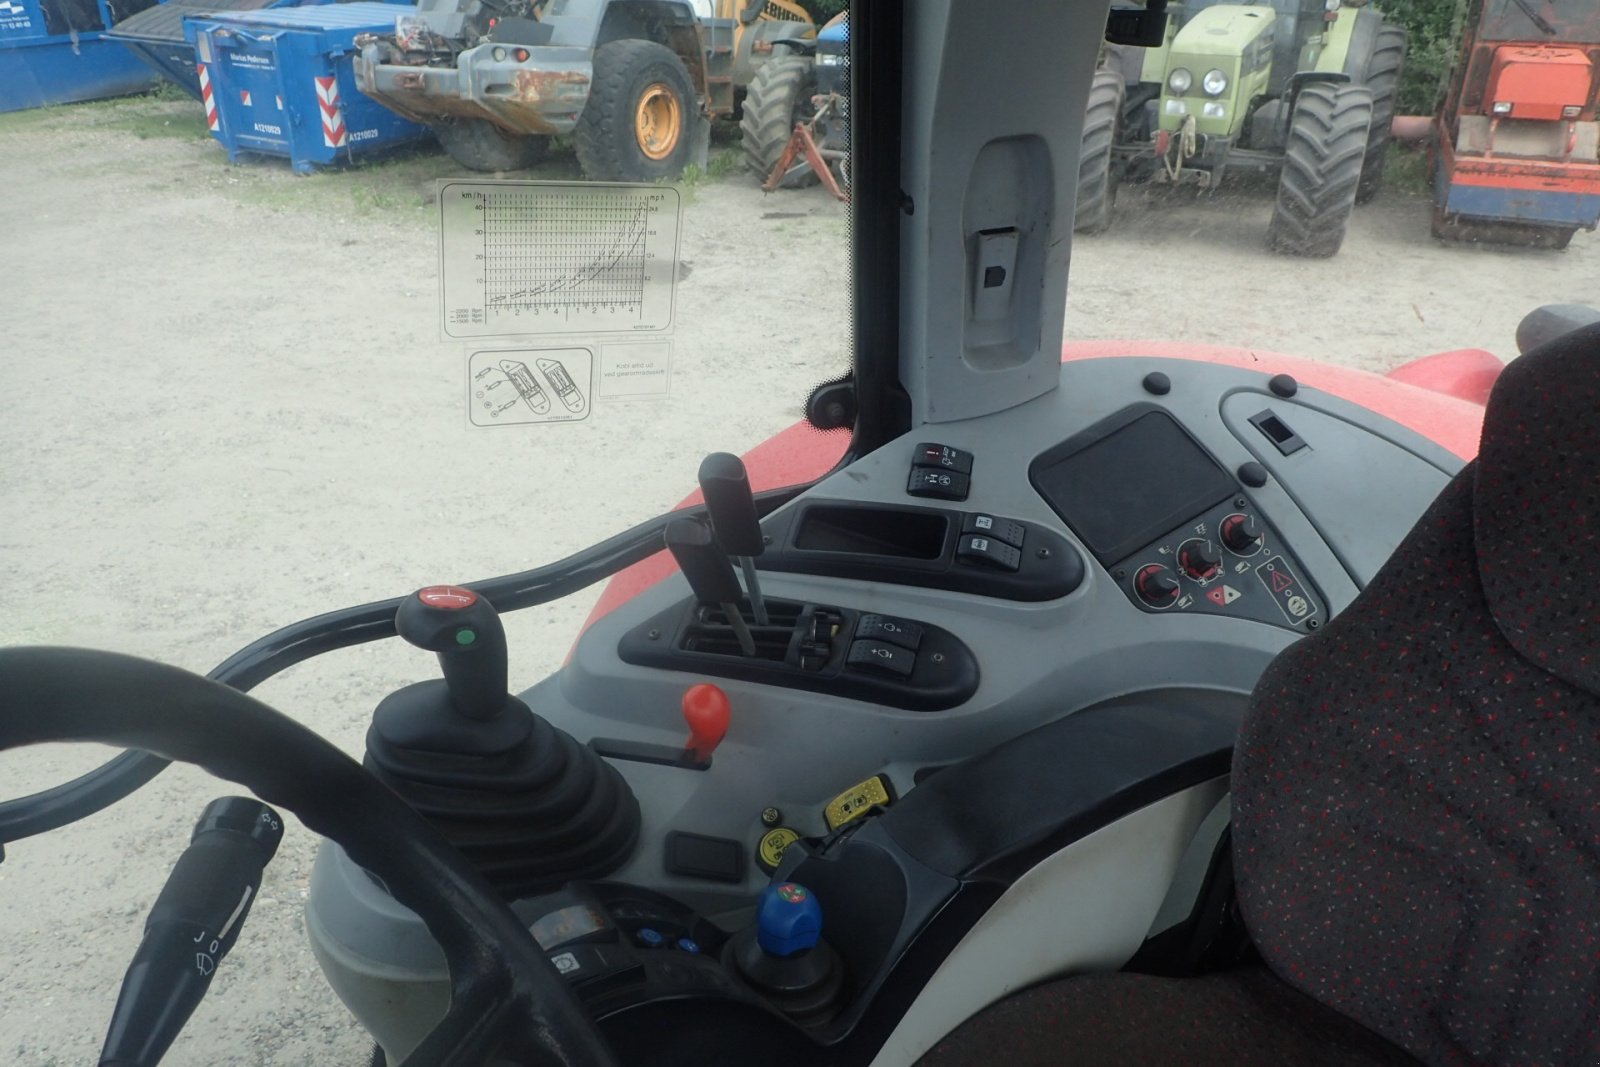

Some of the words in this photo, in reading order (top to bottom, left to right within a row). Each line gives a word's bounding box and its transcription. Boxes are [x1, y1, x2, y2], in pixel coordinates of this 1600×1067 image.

[349, 128, 378, 142] A1210029
[514, 307, 520, 316] 2
[534, 307, 540, 316] 3
[553, 306, 559, 314] 4
[591, 304, 597, 313] 2
[609, 304, 615, 313] 3
[628, 304, 634, 312] 4
